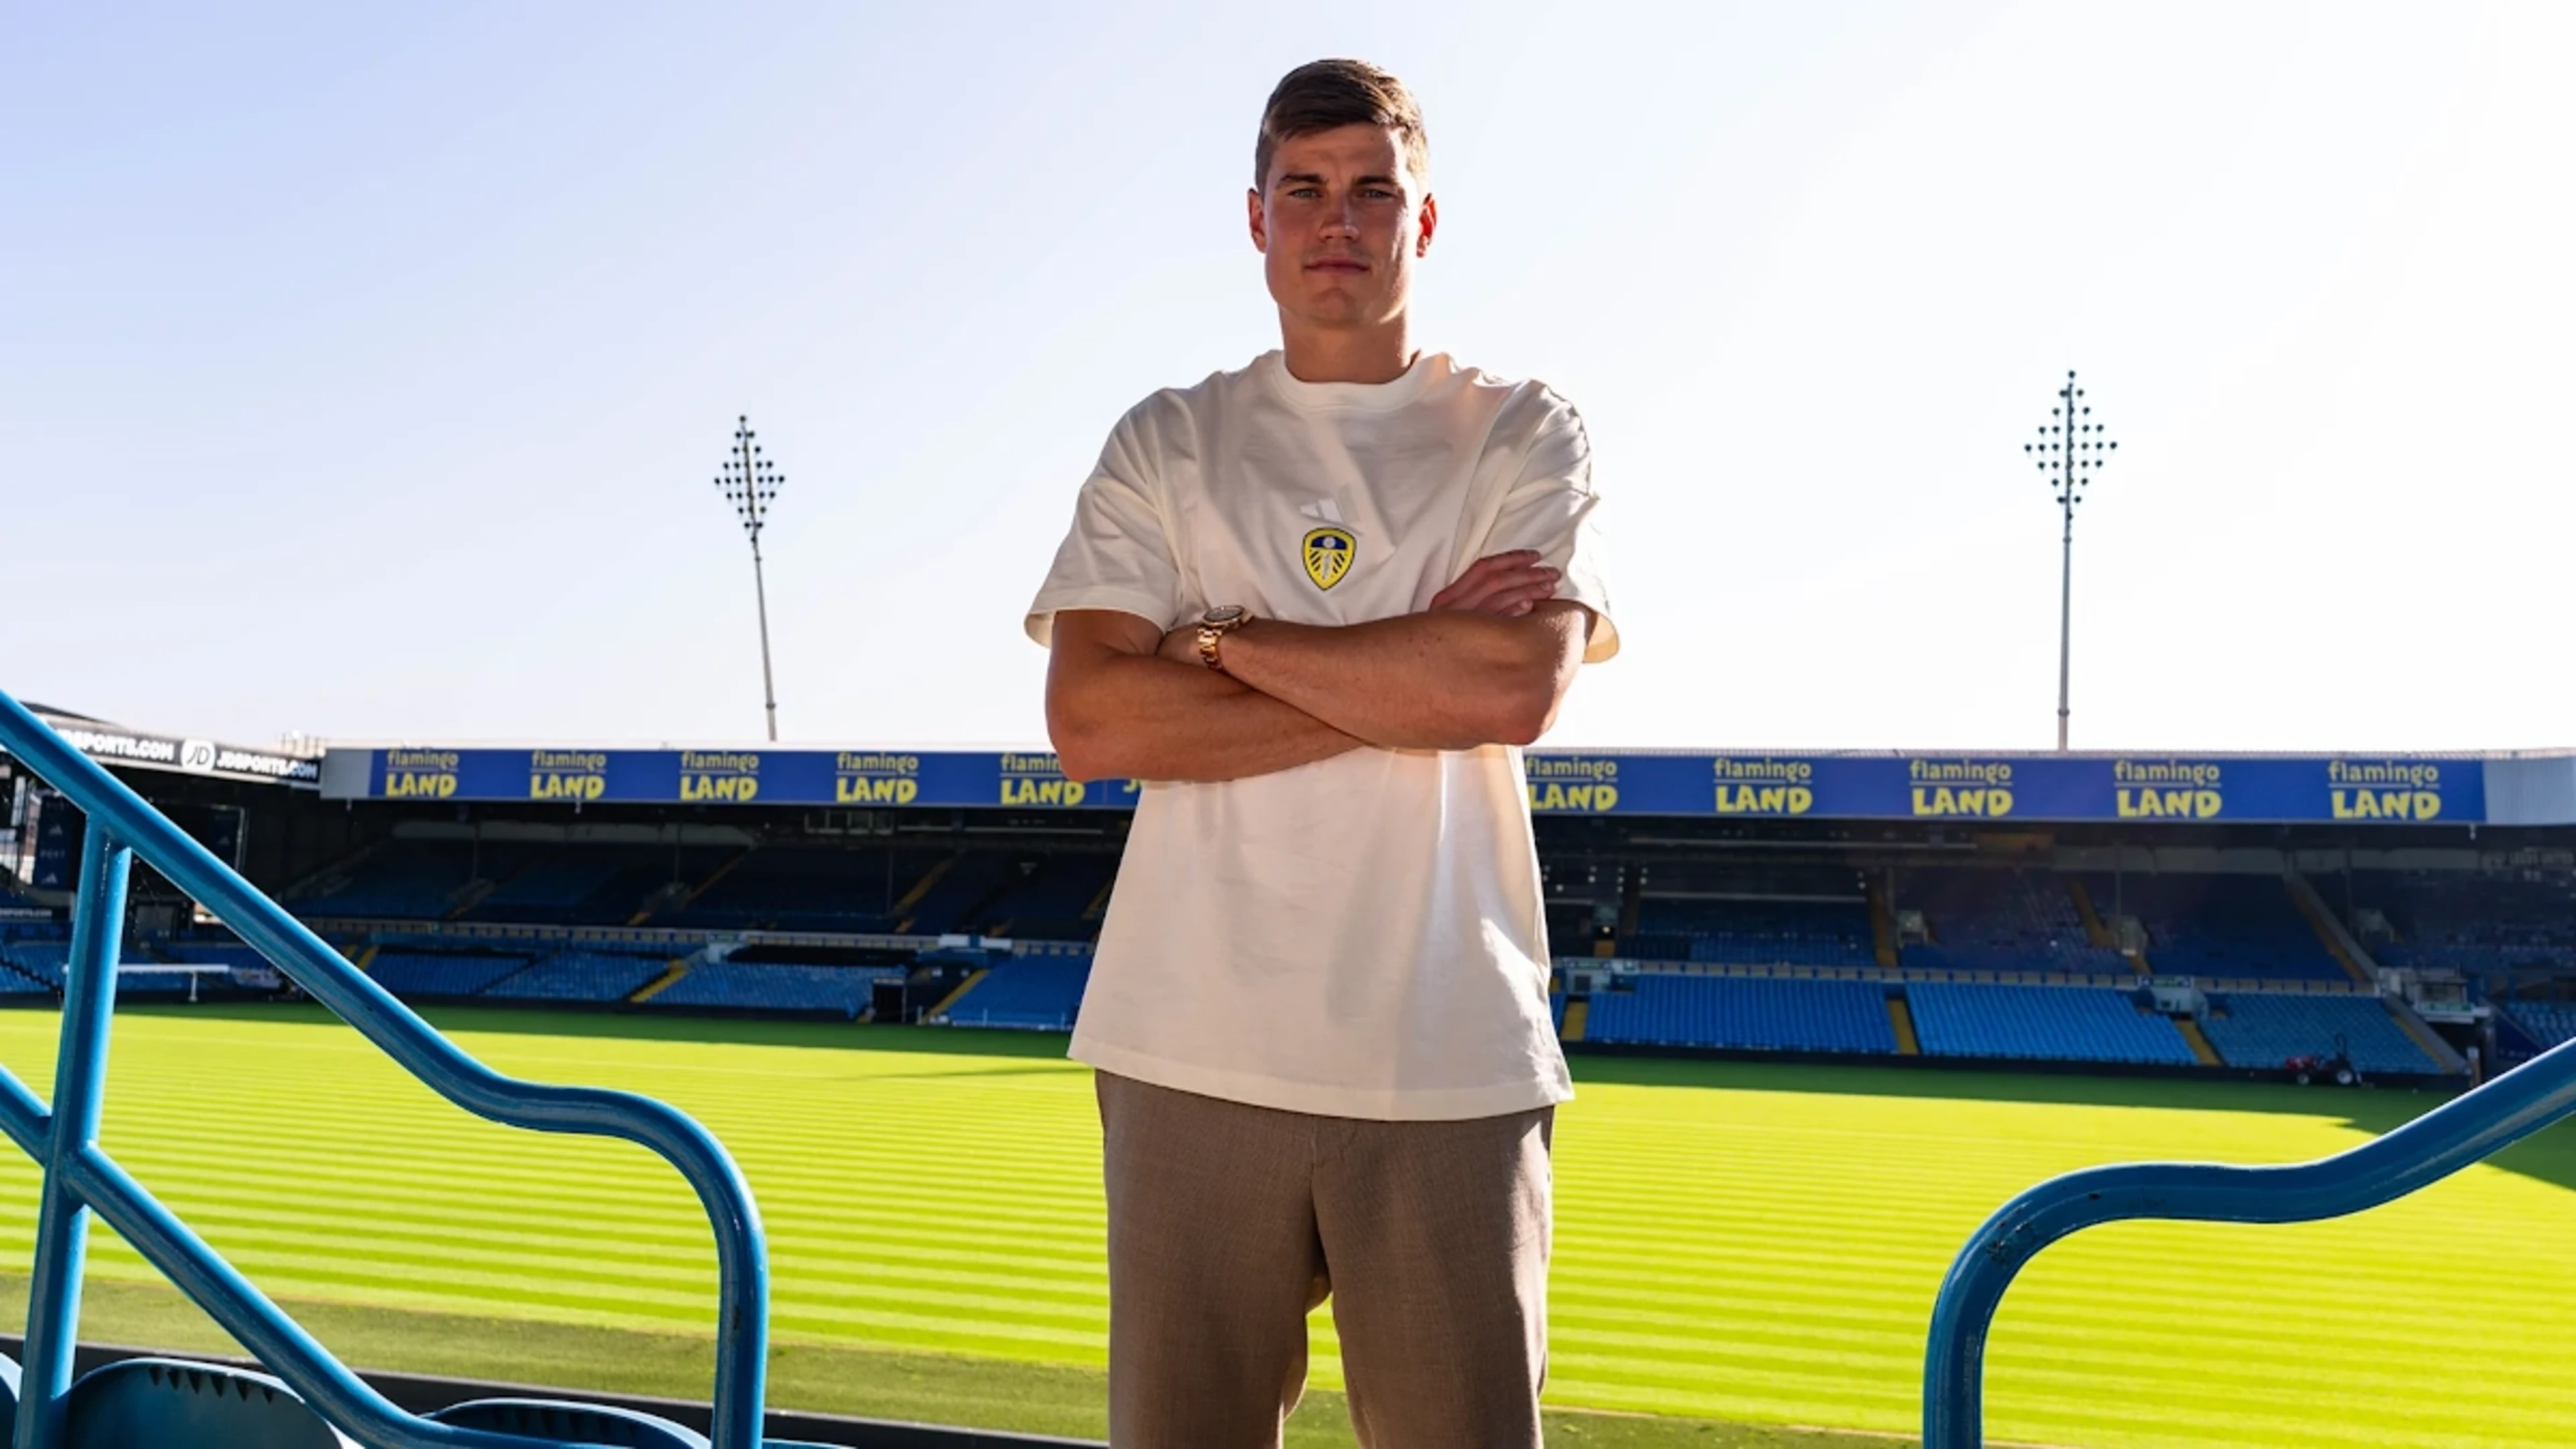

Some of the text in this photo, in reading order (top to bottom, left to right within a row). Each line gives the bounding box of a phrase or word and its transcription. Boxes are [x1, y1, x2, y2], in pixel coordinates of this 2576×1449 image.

[216, 751, 318, 779] JDSPORTS.COM
[388, 749, 459, 769] flamingo
[532, 750, 606, 771] flamingo
[681, 751, 759, 773] flamingo
[837, 752, 918, 775] flamingo
[1001, 753, 1061, 771] flamin
[1526, 757, 1617, 781] flamingo
[1715, 758, 1811, 782] flamingo
[1910, 759, 2011, 784] flamingo
[386, 771, 456, 798] LAND
[531, 773, 604, 800] LAND
[2114, 760, 2220, 786] flamingo
[2328, 760, 2439, 787] flamingo
[680, 775, 757, 802] LAND
[836, 776, 917, 804] LAND
[1000, 778, 1085, 807] LAND
[1527, 784, 1617, 811] LAND
[1715, 785, 1812, 814] LAND
[1913, 788, 2012, 817] LAND
[2117, 788, 2221, 818] LAND
[2332, 789, 2440, 820] LAND
